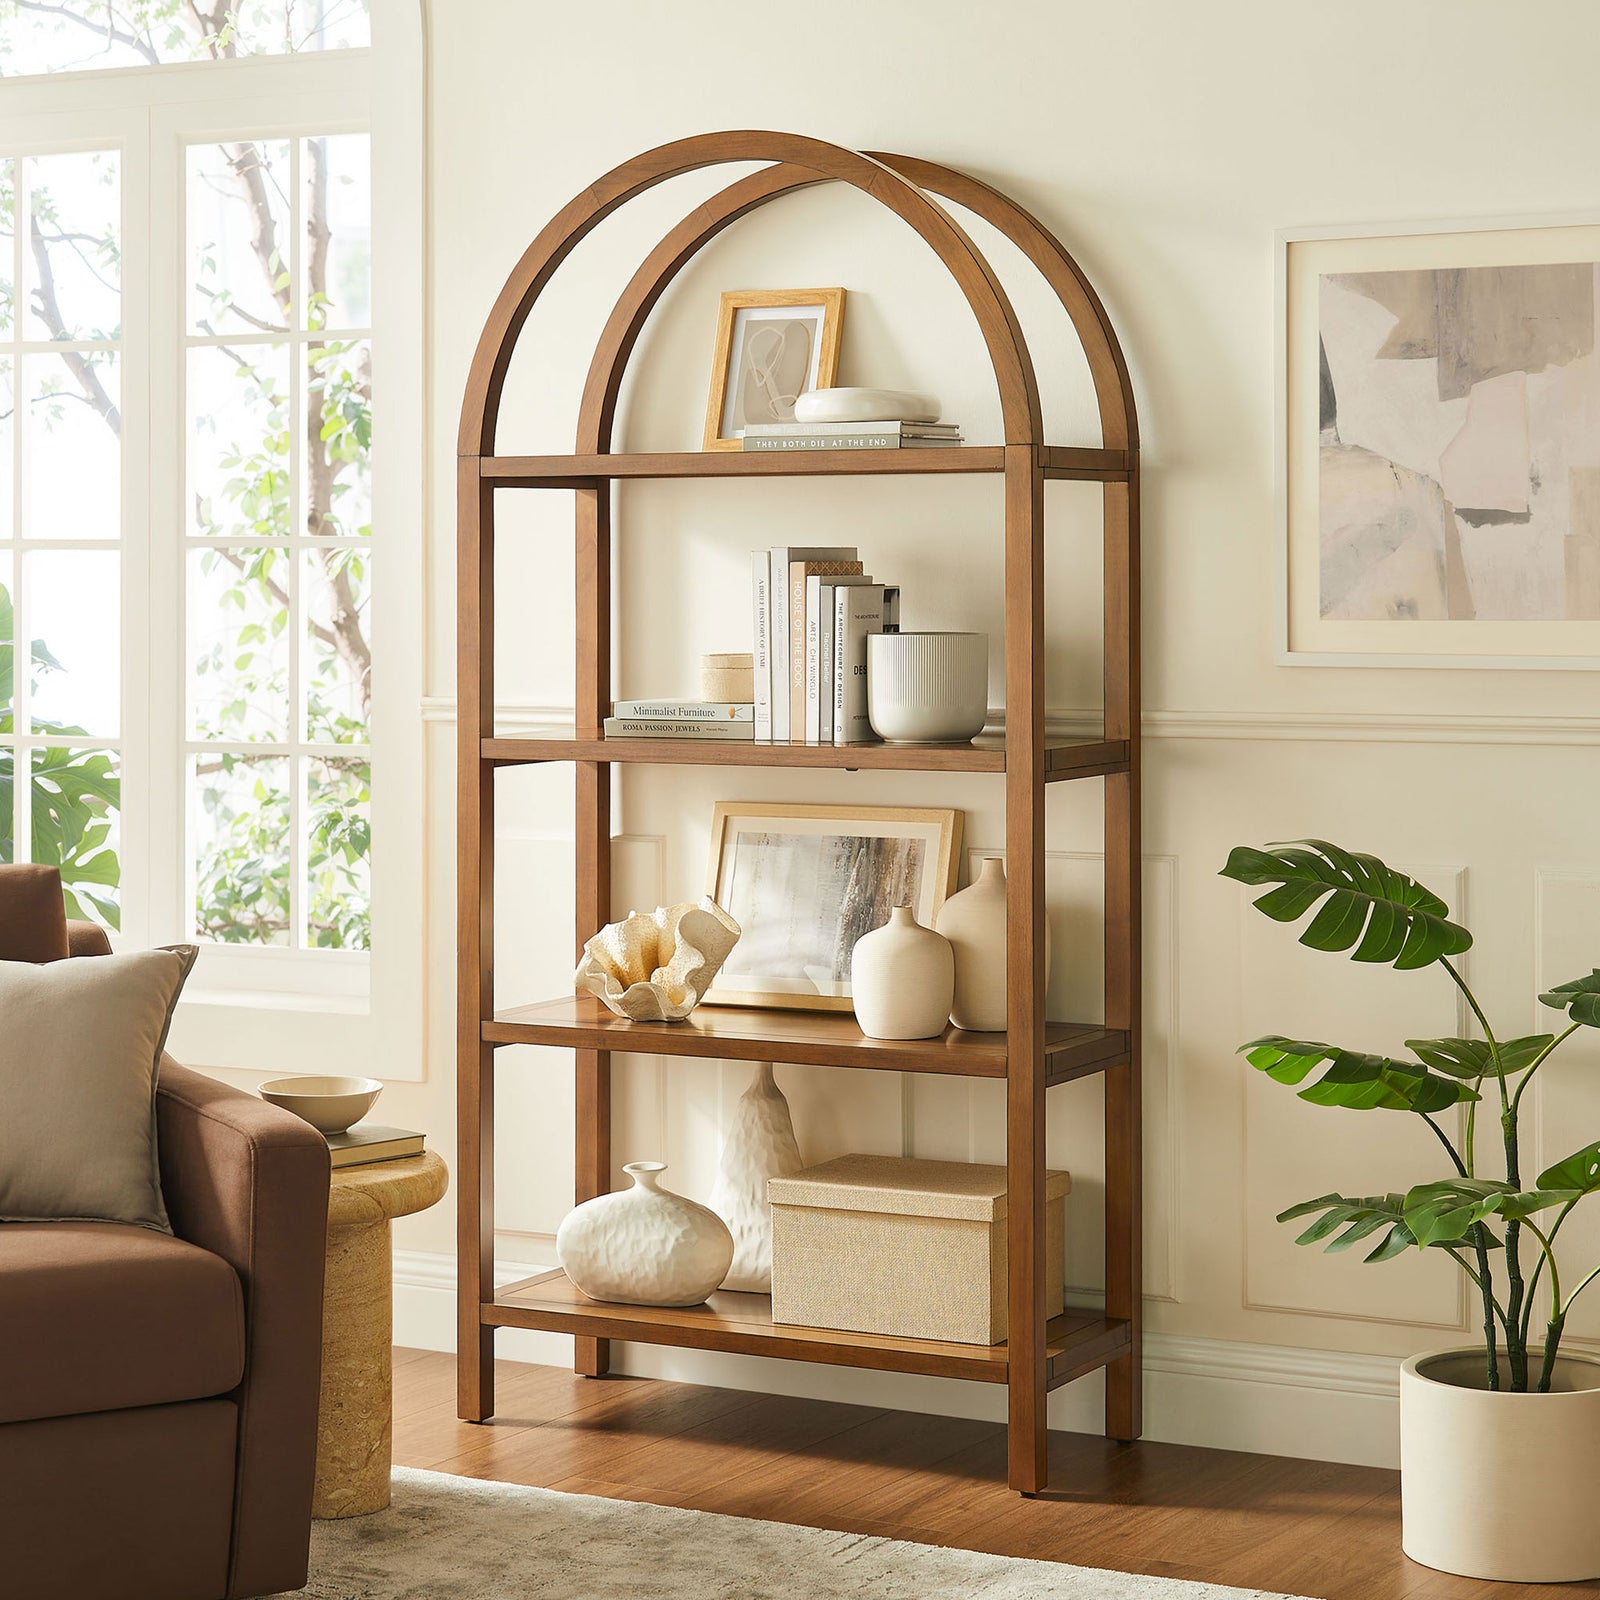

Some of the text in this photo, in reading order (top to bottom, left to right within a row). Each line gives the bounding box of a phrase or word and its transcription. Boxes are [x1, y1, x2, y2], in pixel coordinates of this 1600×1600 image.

[793, 580, 803, 688] HOUSE OF THE BOOK
[809, 620, 817, 642] ARTS
[838, 672, 843, 681] OF
[633, 706, 716, 717] Minimalist Furniture
